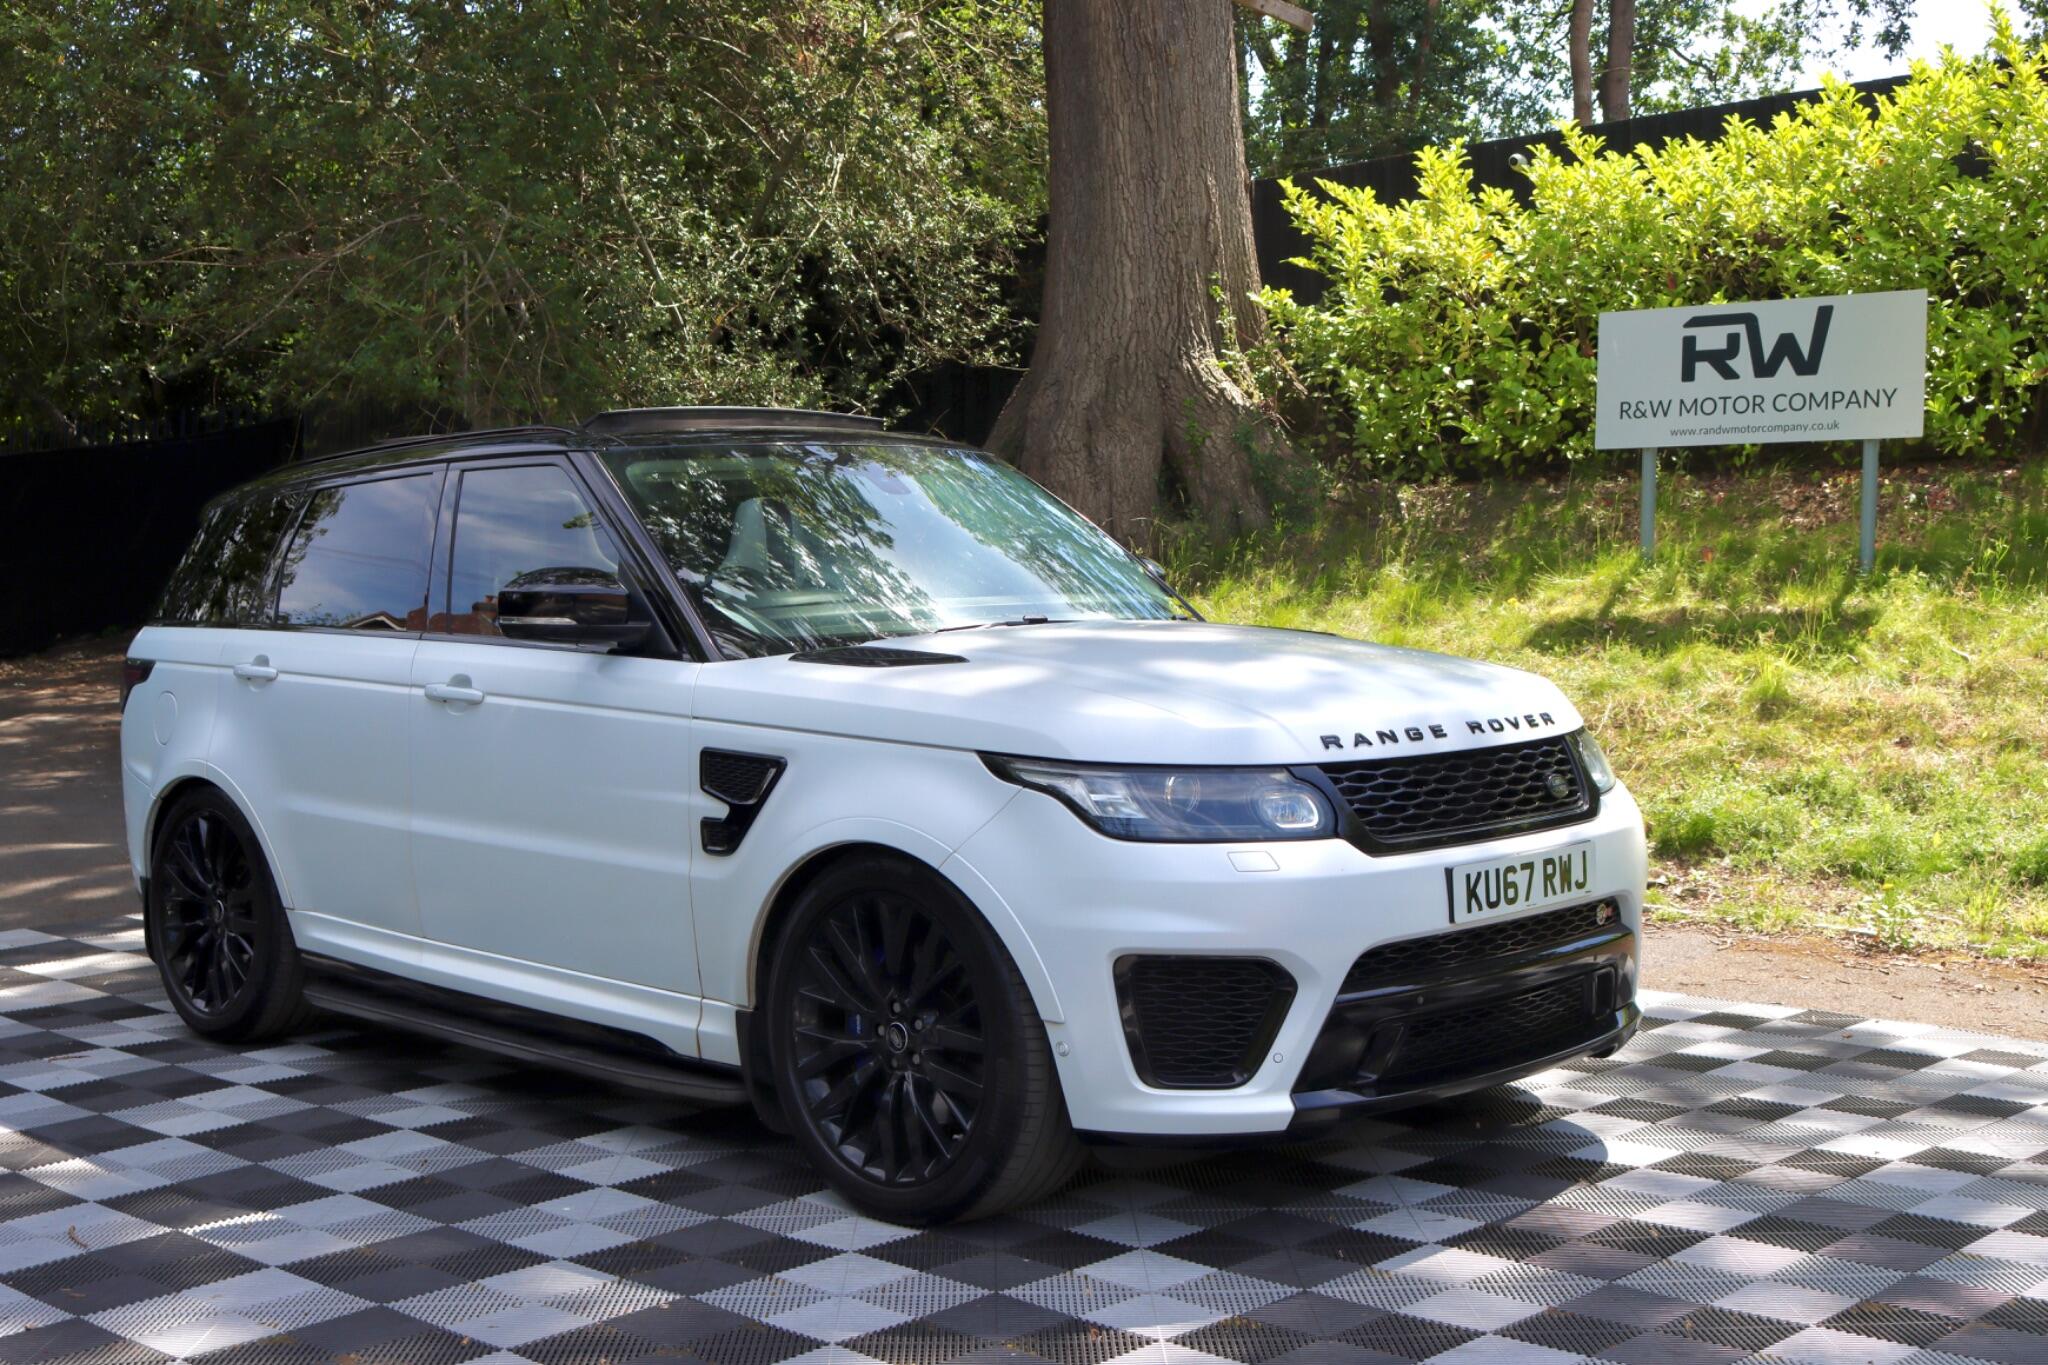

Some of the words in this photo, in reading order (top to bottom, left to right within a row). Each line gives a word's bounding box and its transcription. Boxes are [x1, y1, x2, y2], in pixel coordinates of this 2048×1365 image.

[1619, 399, 1671, 420] R&W
[1679, 394, 1765, 417] MOTOR
[1773, 388, 1898, 412] COMPANY
[1670, 420, 1840, 437] www.randwmotorcompany.co.uk
[1320, 724, 1447, 750] RANGE
[1466, 712, 1555, 734] ROVER
[1465, 861, 1535, 914] KU67
[1542, 850, 1587, 897] RWJ
